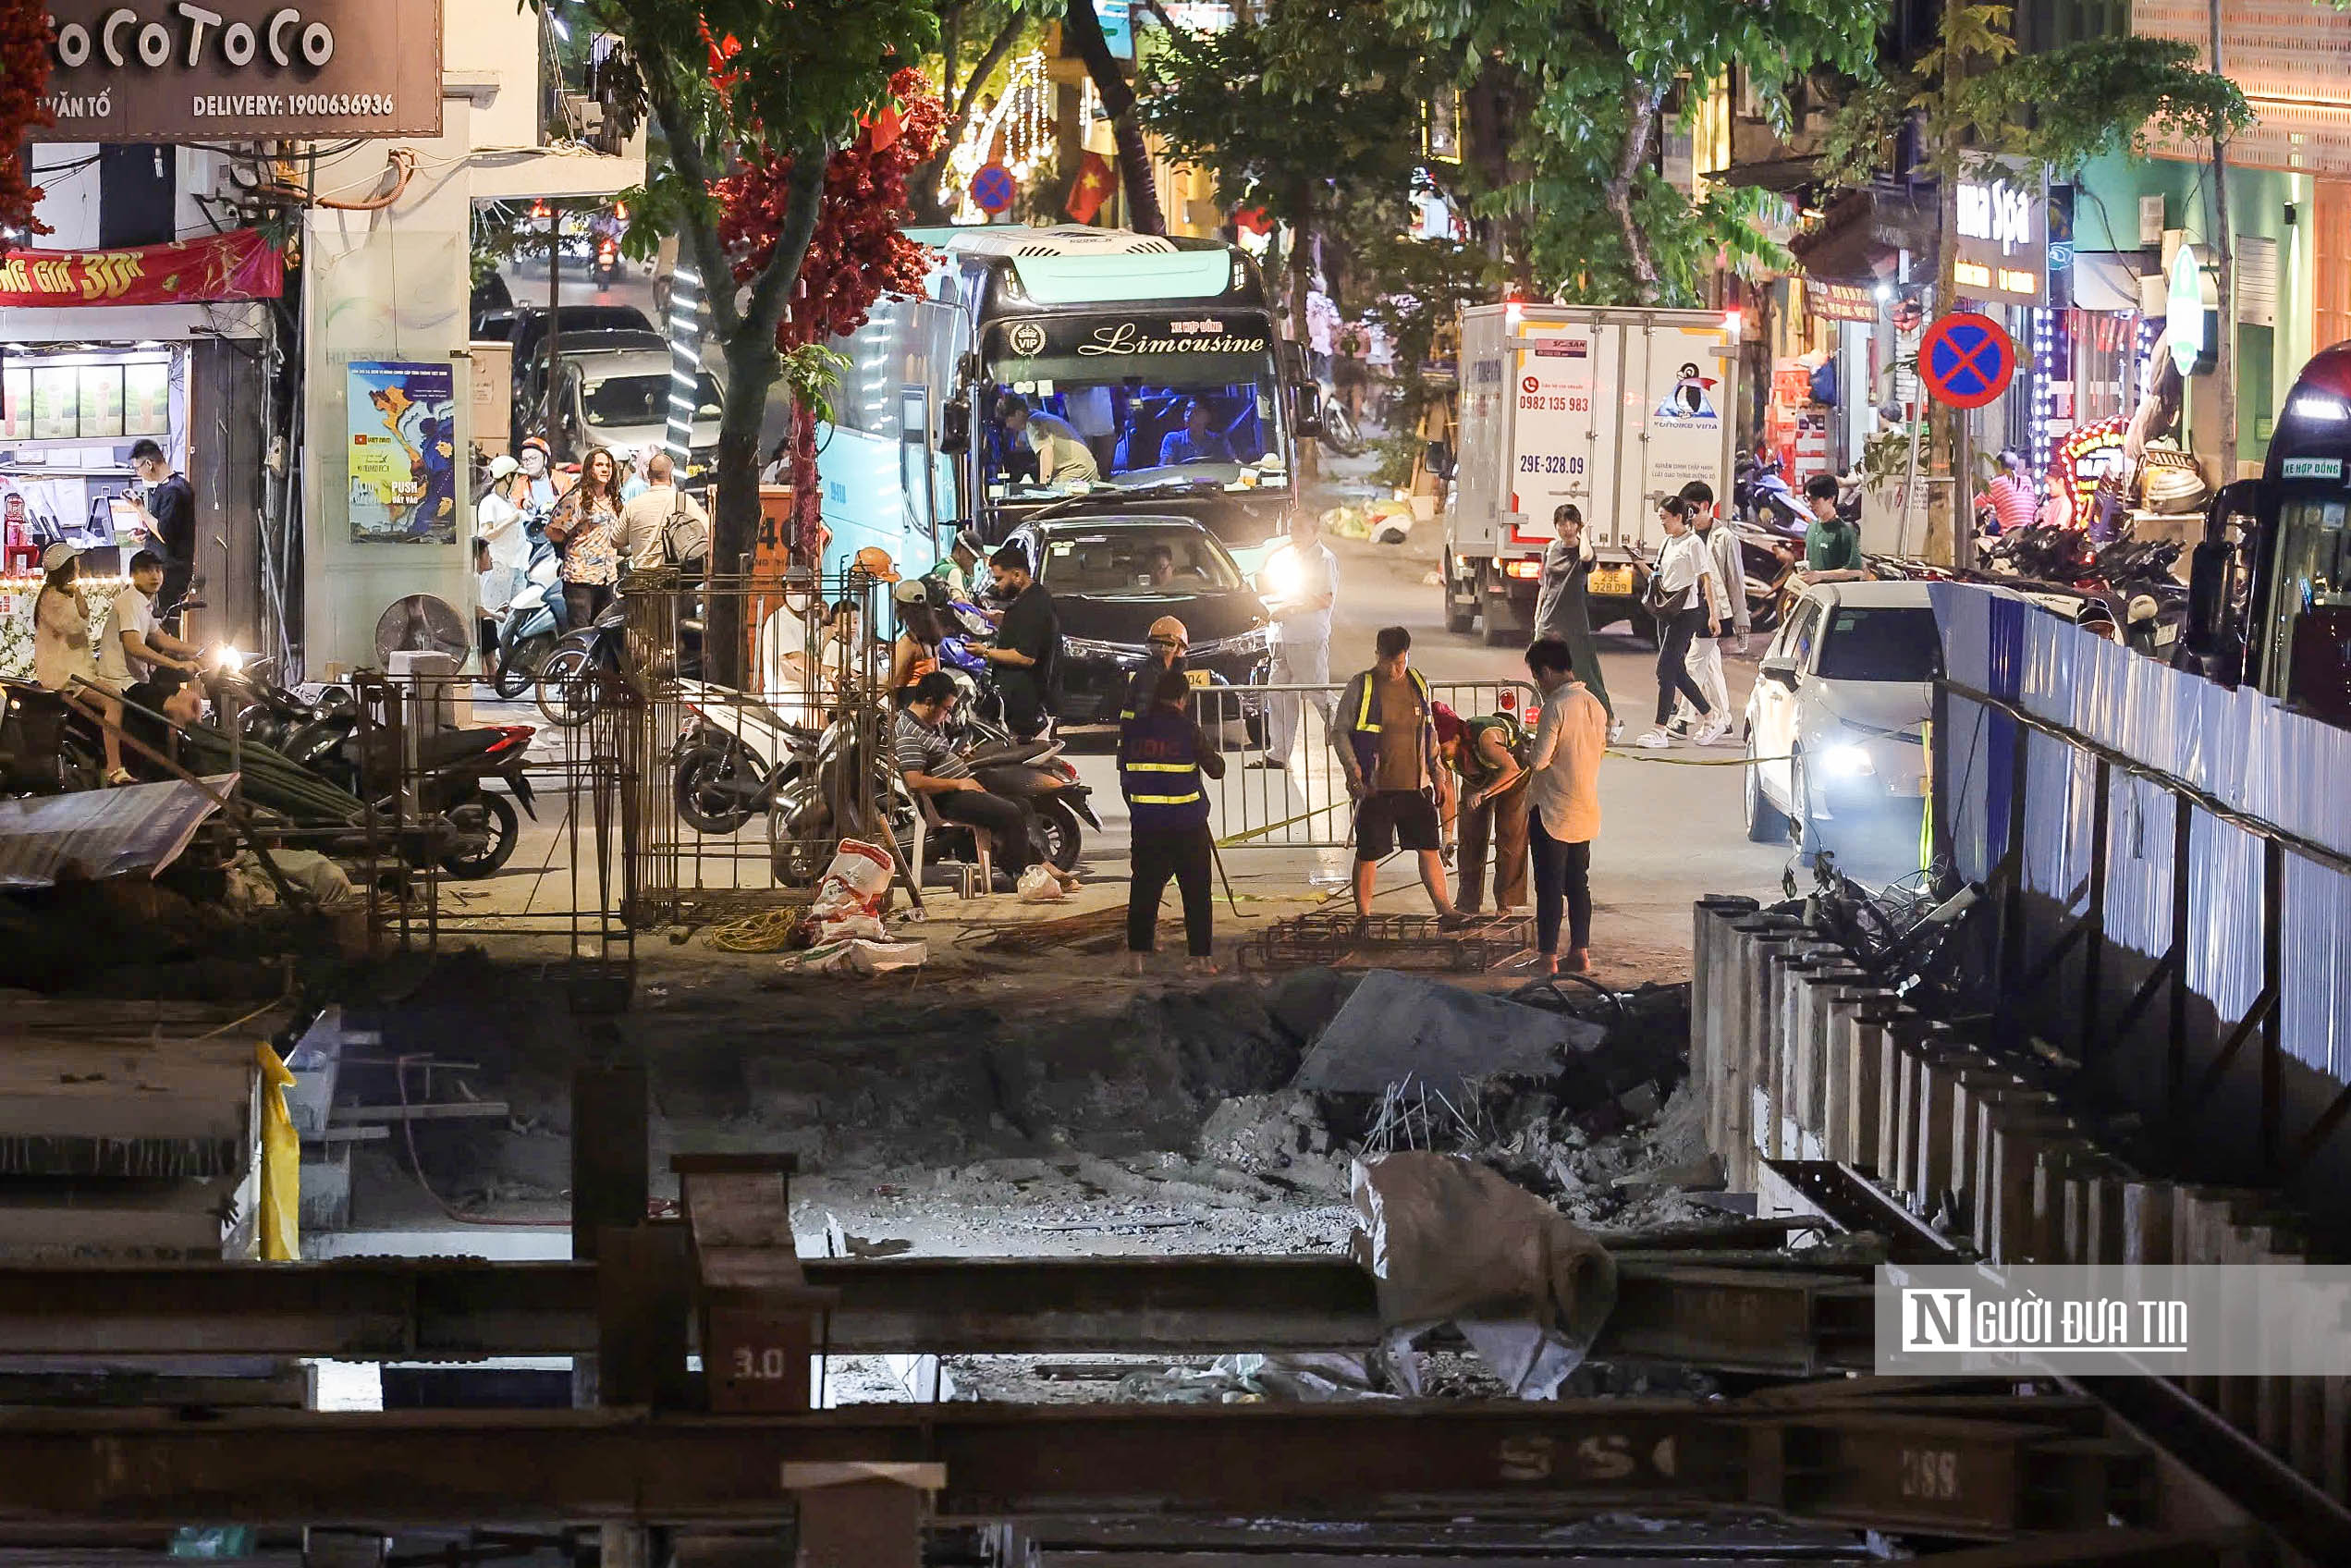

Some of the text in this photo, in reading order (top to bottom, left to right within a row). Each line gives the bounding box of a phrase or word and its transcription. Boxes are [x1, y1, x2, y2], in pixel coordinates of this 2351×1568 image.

[47, 2, 334, 67] oCoToCo
[45, 91, 83, 117] VĂN
[87, 86, 111, 117] TỐ
[193, 93, 394, 116] DELIVERY: 1900636936
[1991, 178, 2030, 256] Spa
[0, 258, 32, 293] NG
[32, 254, 77, 293] GIÁ
[1018, 338, 1036, 349] VIP
[1077, 324, 1265, 356] Limousine
[1520, 396, 1588, 411] 0982 135 983
[1520, 454, 1584, 474] 29E-328.09
[391, 481, 418, 494] PUSH
[733, 1346, 785, 1378] 3.0
